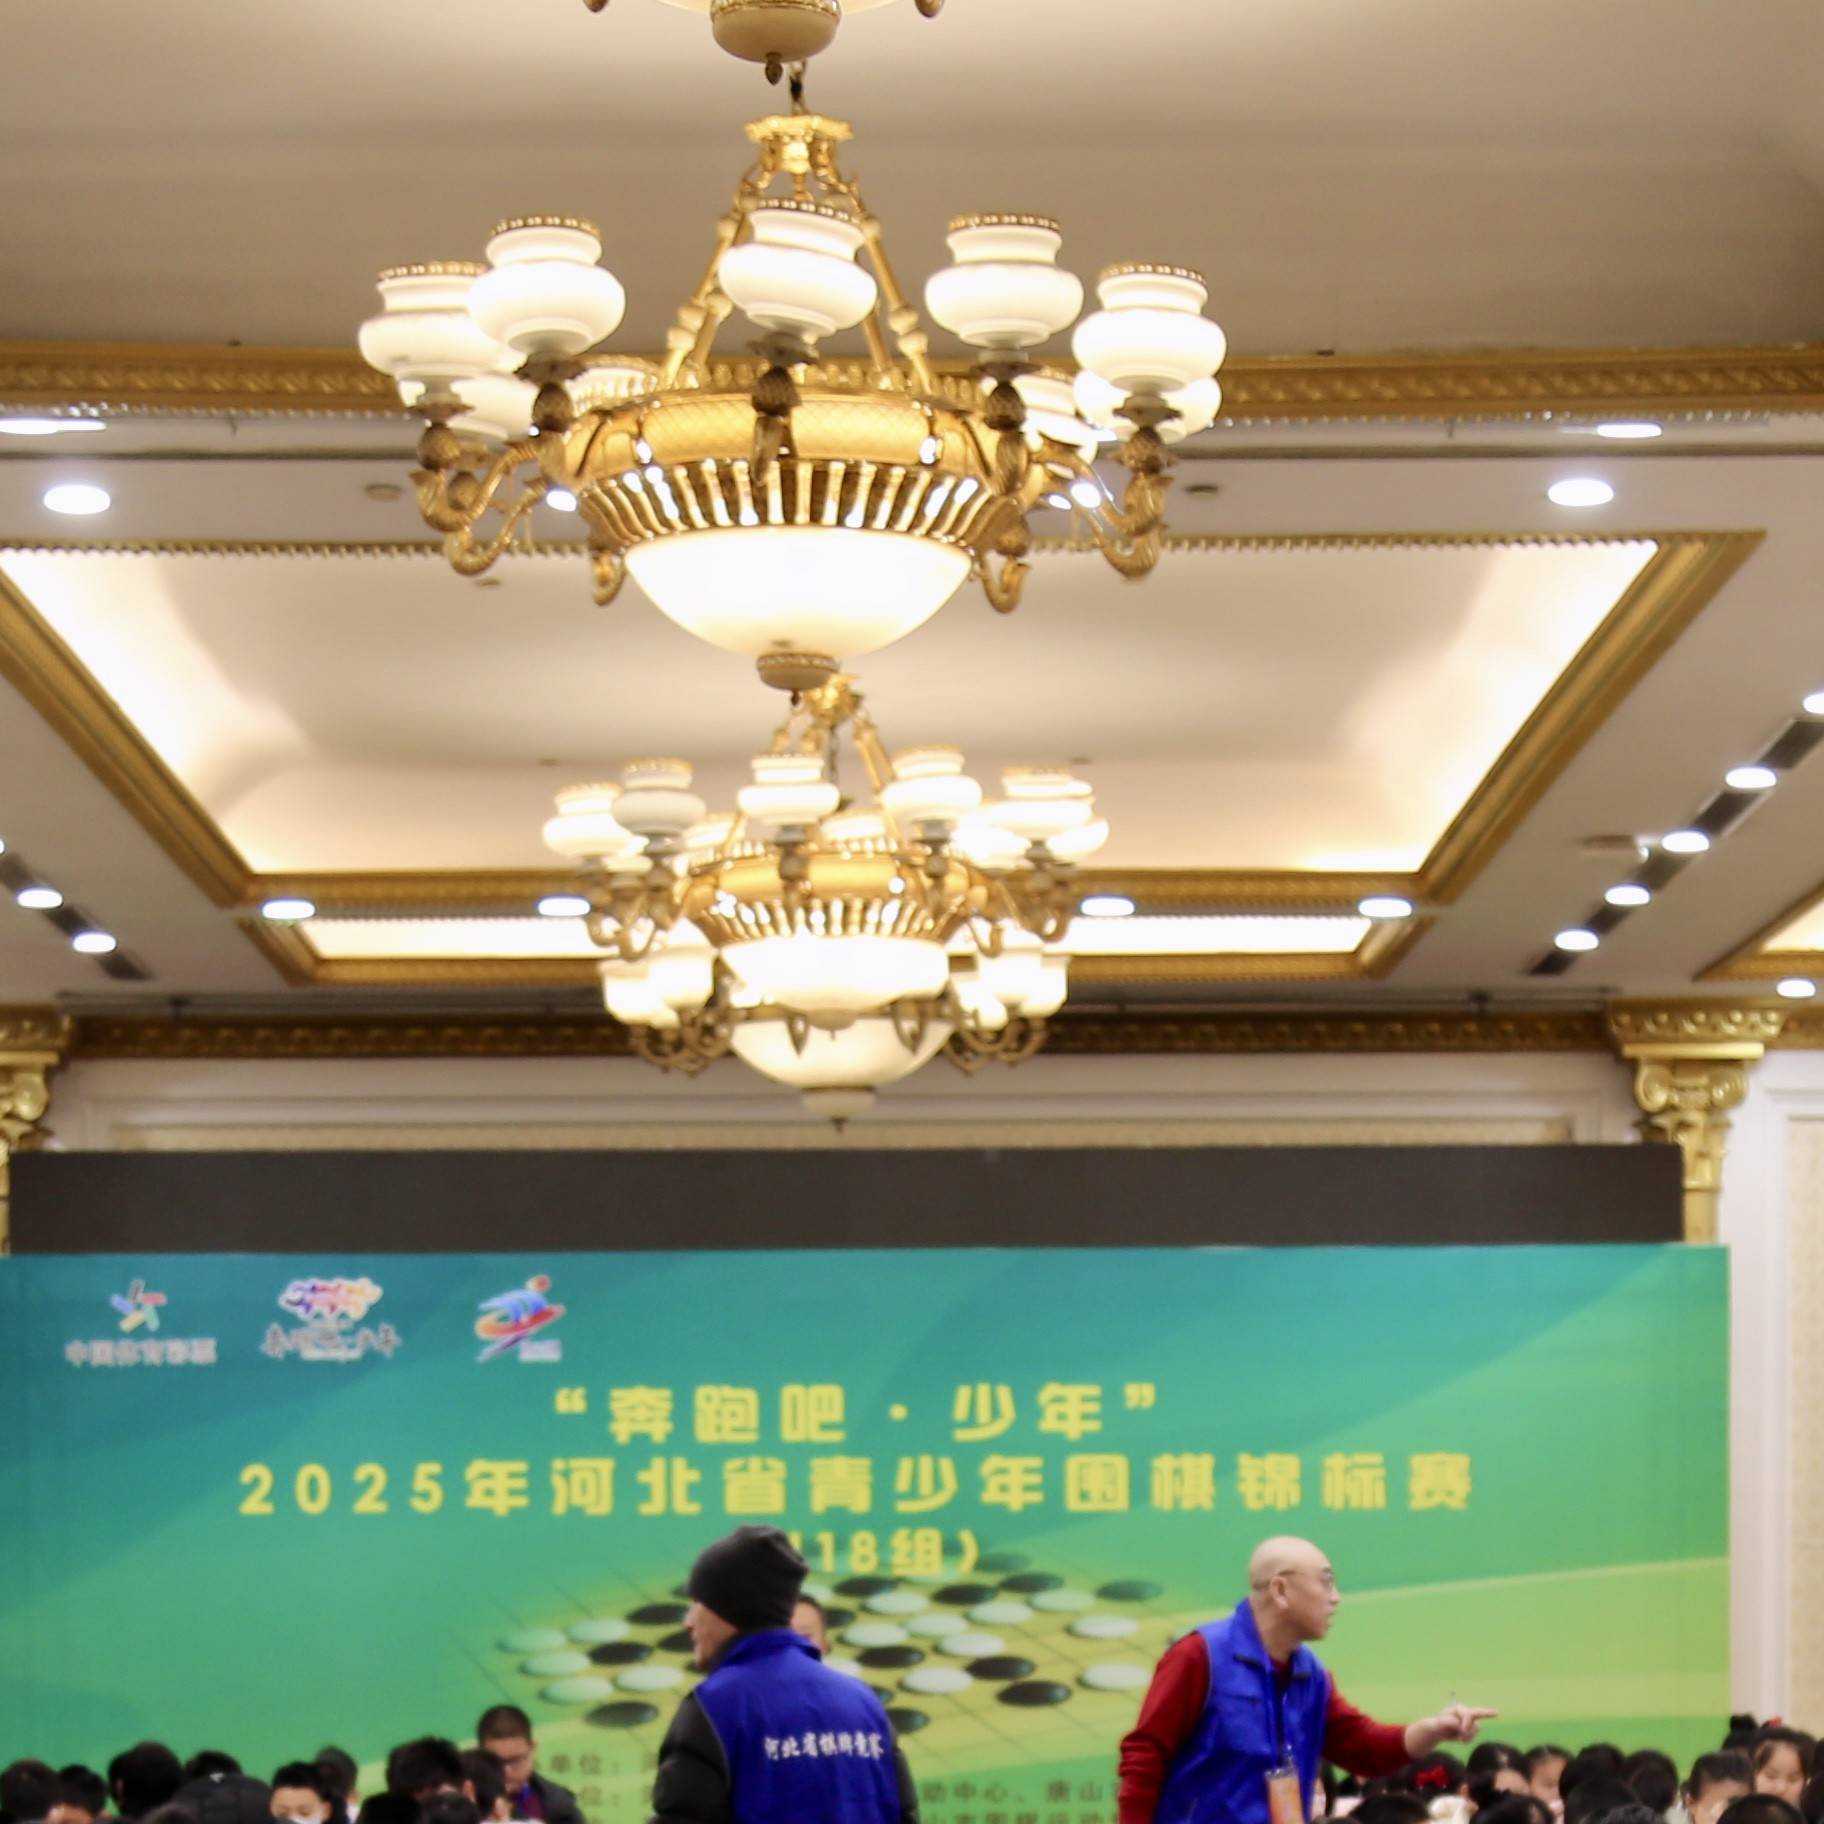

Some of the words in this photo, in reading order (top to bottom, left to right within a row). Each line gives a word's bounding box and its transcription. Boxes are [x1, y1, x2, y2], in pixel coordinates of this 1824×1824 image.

[238, 1454, 1471, 1515] 2025年河北省青少年围棋锦标赛
